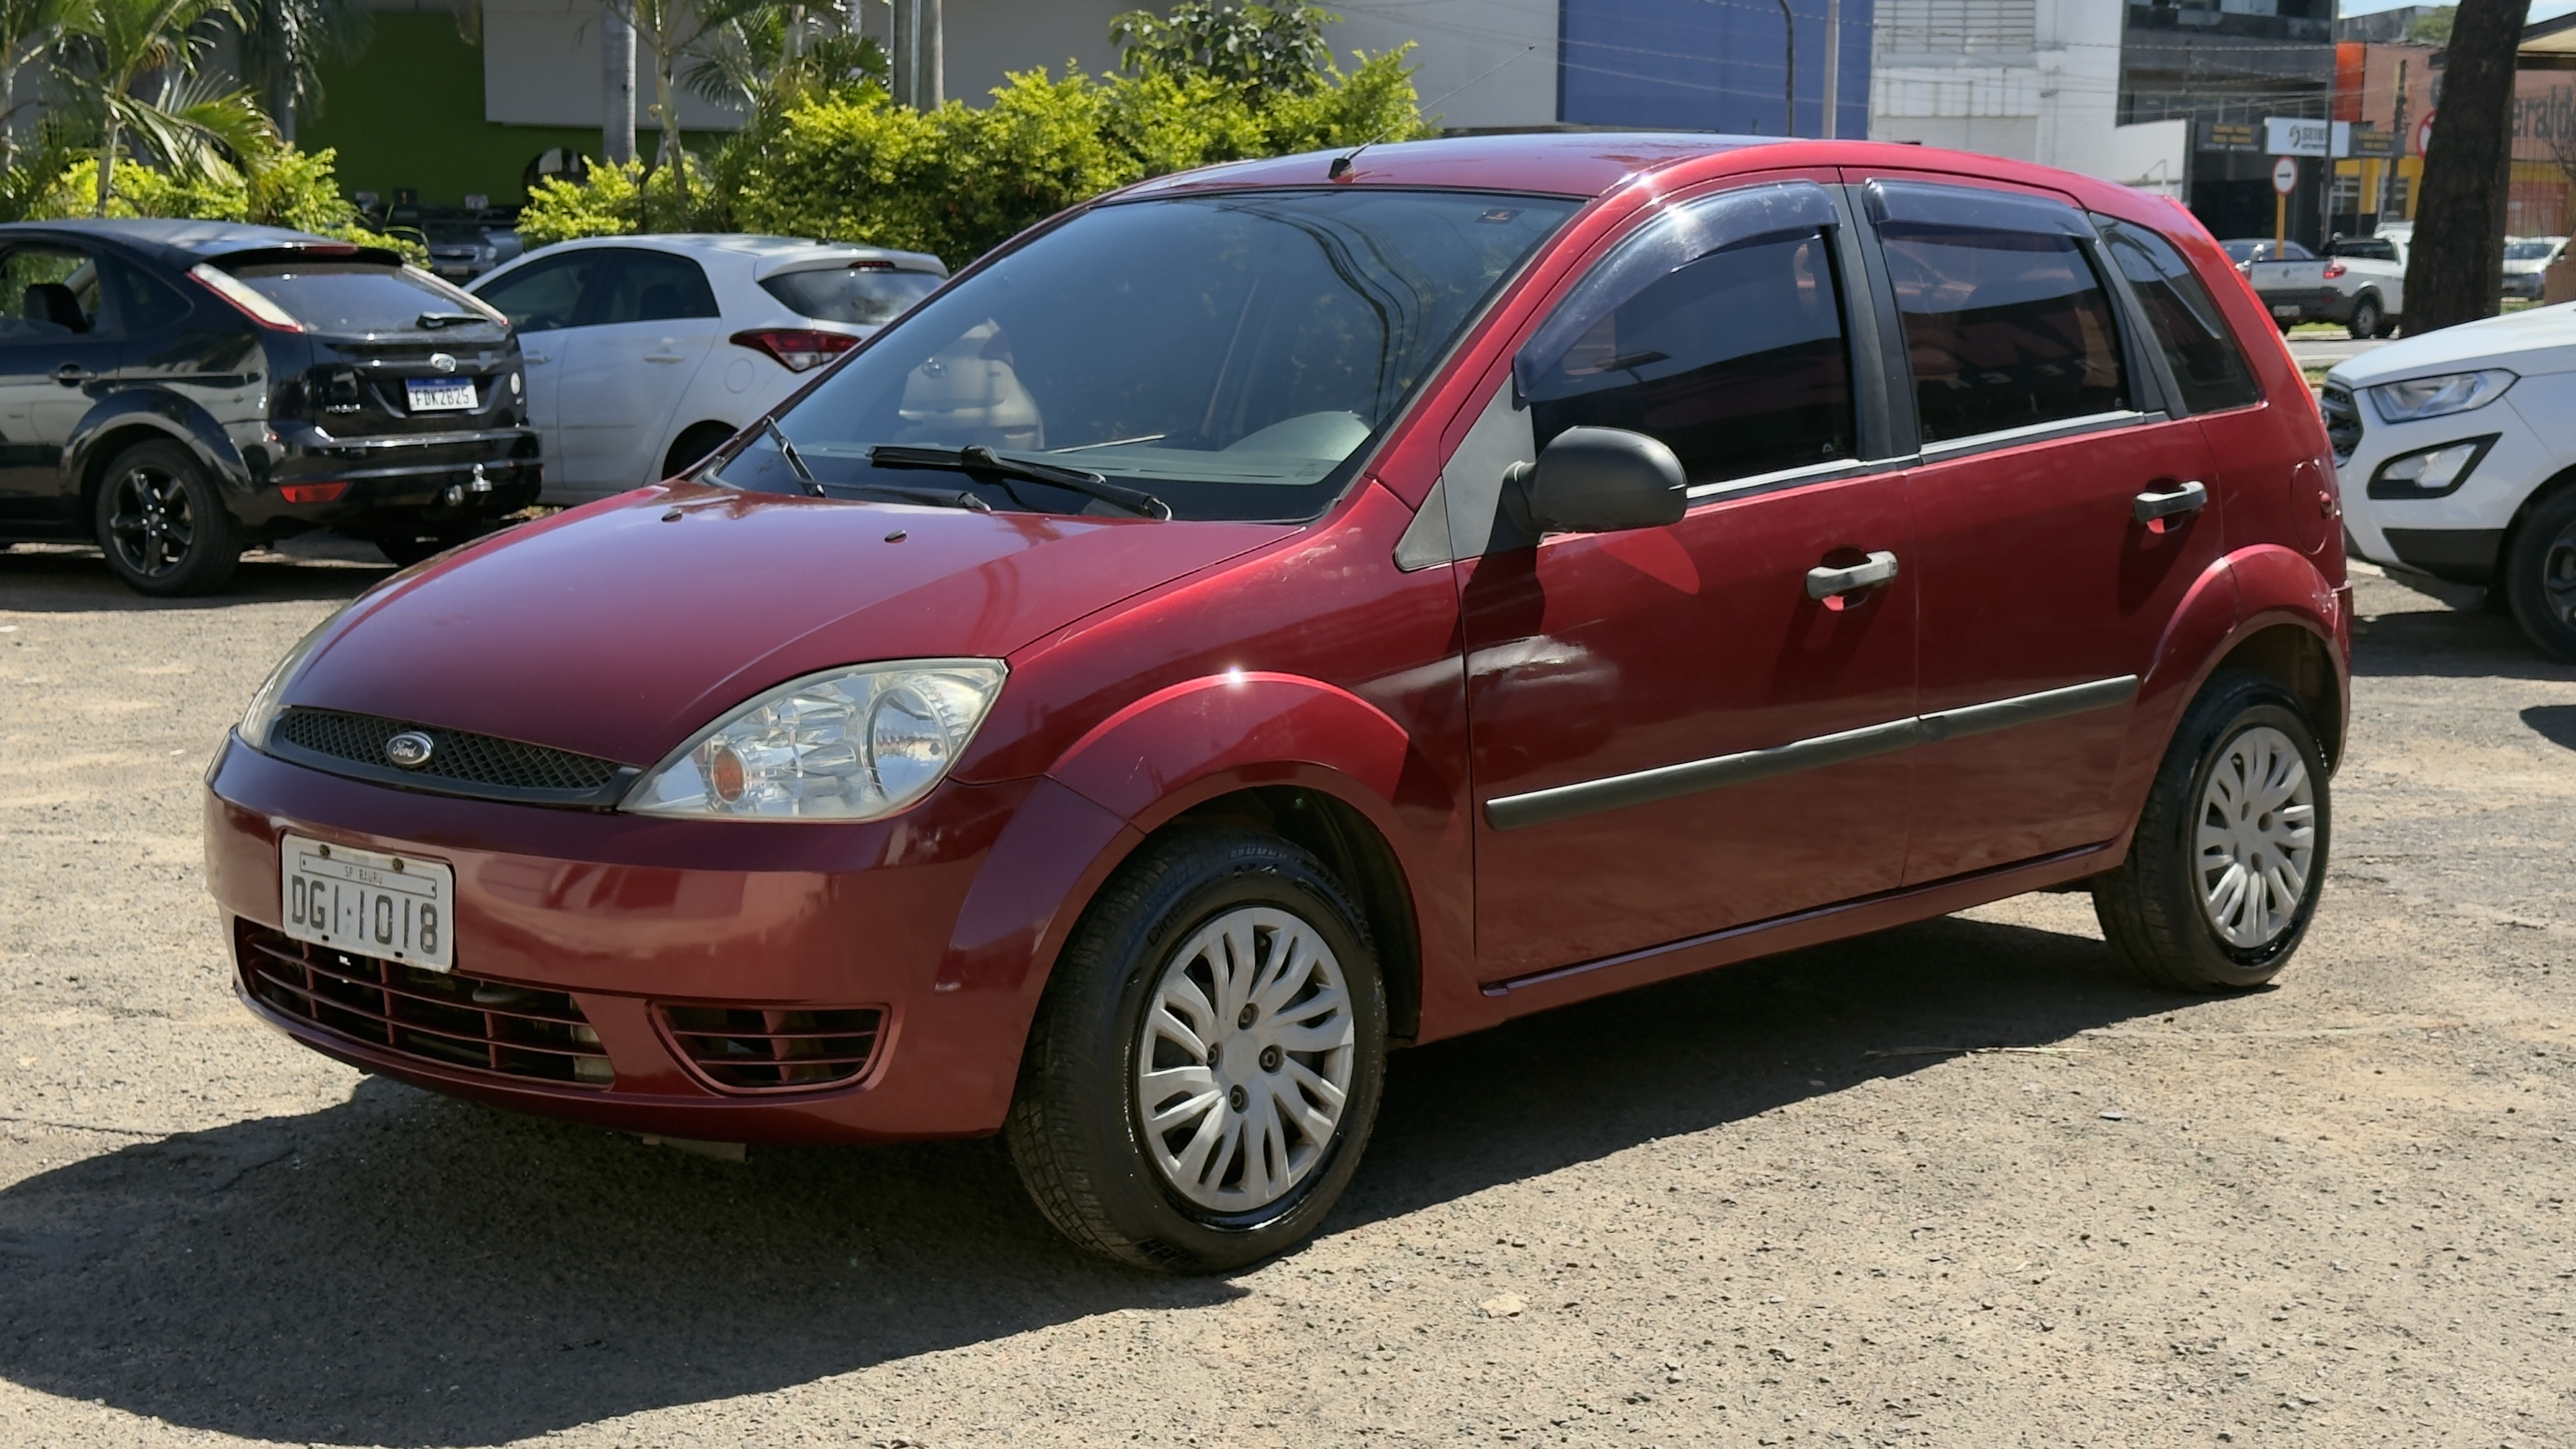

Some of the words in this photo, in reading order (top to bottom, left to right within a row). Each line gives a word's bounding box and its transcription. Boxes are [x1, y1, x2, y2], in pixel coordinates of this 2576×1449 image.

[2513, 83, 2576, 140] erald
[415, 387, 470, 406] FDK2B25
[393, 739, 418, 758] Ford
